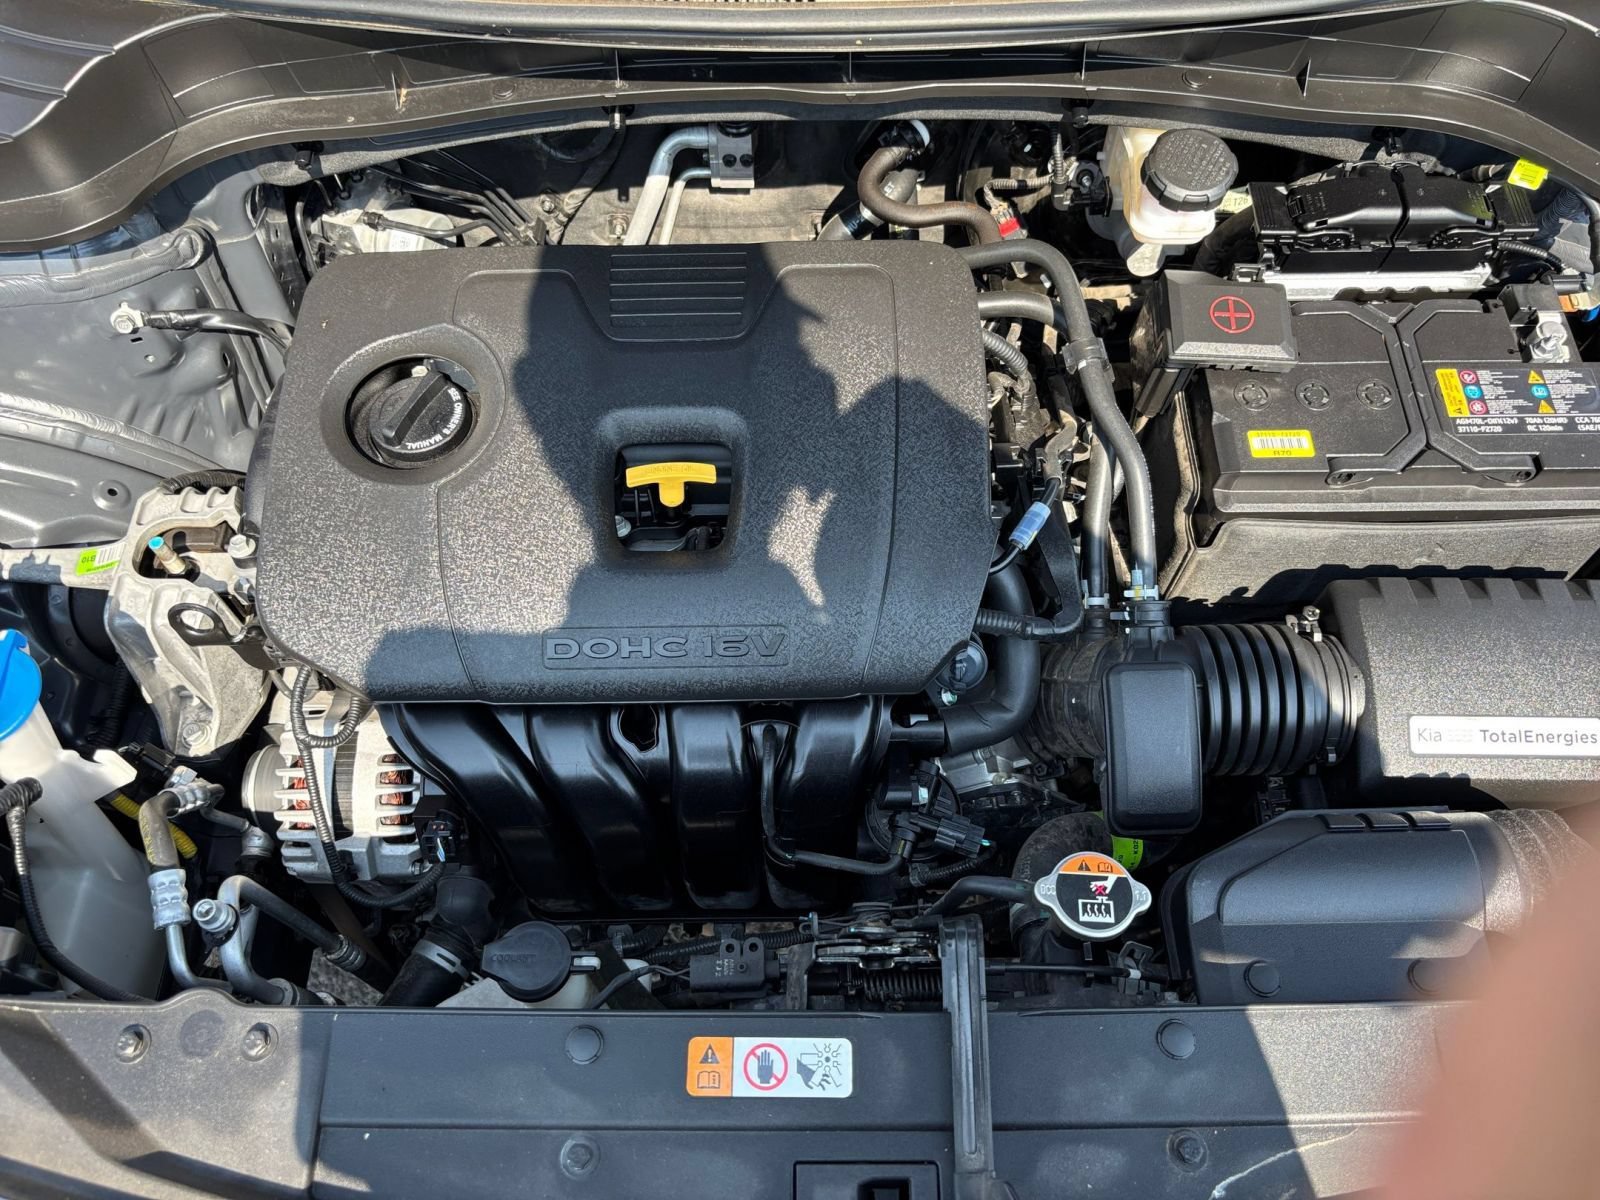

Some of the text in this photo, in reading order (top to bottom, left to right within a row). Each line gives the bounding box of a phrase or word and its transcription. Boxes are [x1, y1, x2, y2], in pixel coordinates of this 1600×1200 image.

[448, 387, 461, 401] SEE
[405, 434, 443, 449] MANUAL
[546, 633, 786, 660] DOHC 16V
[1417, 728, 1598, 746] Kia TotalEnergies
